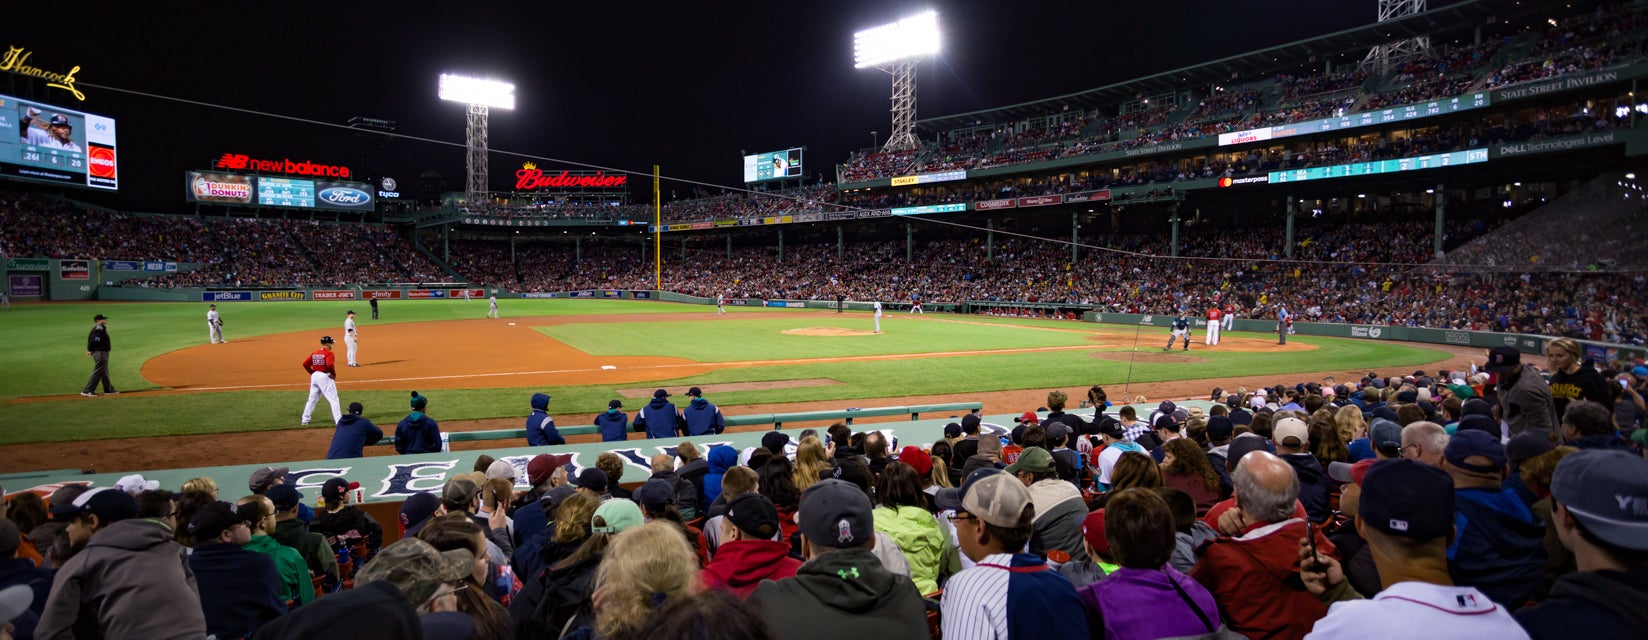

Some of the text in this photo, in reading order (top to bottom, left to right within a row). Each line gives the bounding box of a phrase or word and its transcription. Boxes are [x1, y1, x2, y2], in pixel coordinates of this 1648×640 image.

[1500, 72, 1617, 100] STATE STREET PAVILION
[1231, 135, 1257, 144] LIQUORS
[1527, 138, 1585, 152] Technologies
[1587, 132, 1614, 144] Level
[71, 159, 82, 167] 20
[250, 159, 285, 171] new
[285, 158, 350, 178] balance
[515, 168, 627, 190] Budweiser
[1232, 176, 1268, 185] masterpass
[211, 182, 249, 191] DUNKIN'
[211, 189, 247, 198] DONUTS
[329, 189, 360, 204] Ford
[378, 190, 400, 199] tyco
[214, 291, 241, 300] jetBlue
[261, 291, 305, 300] GRANITE CITY
